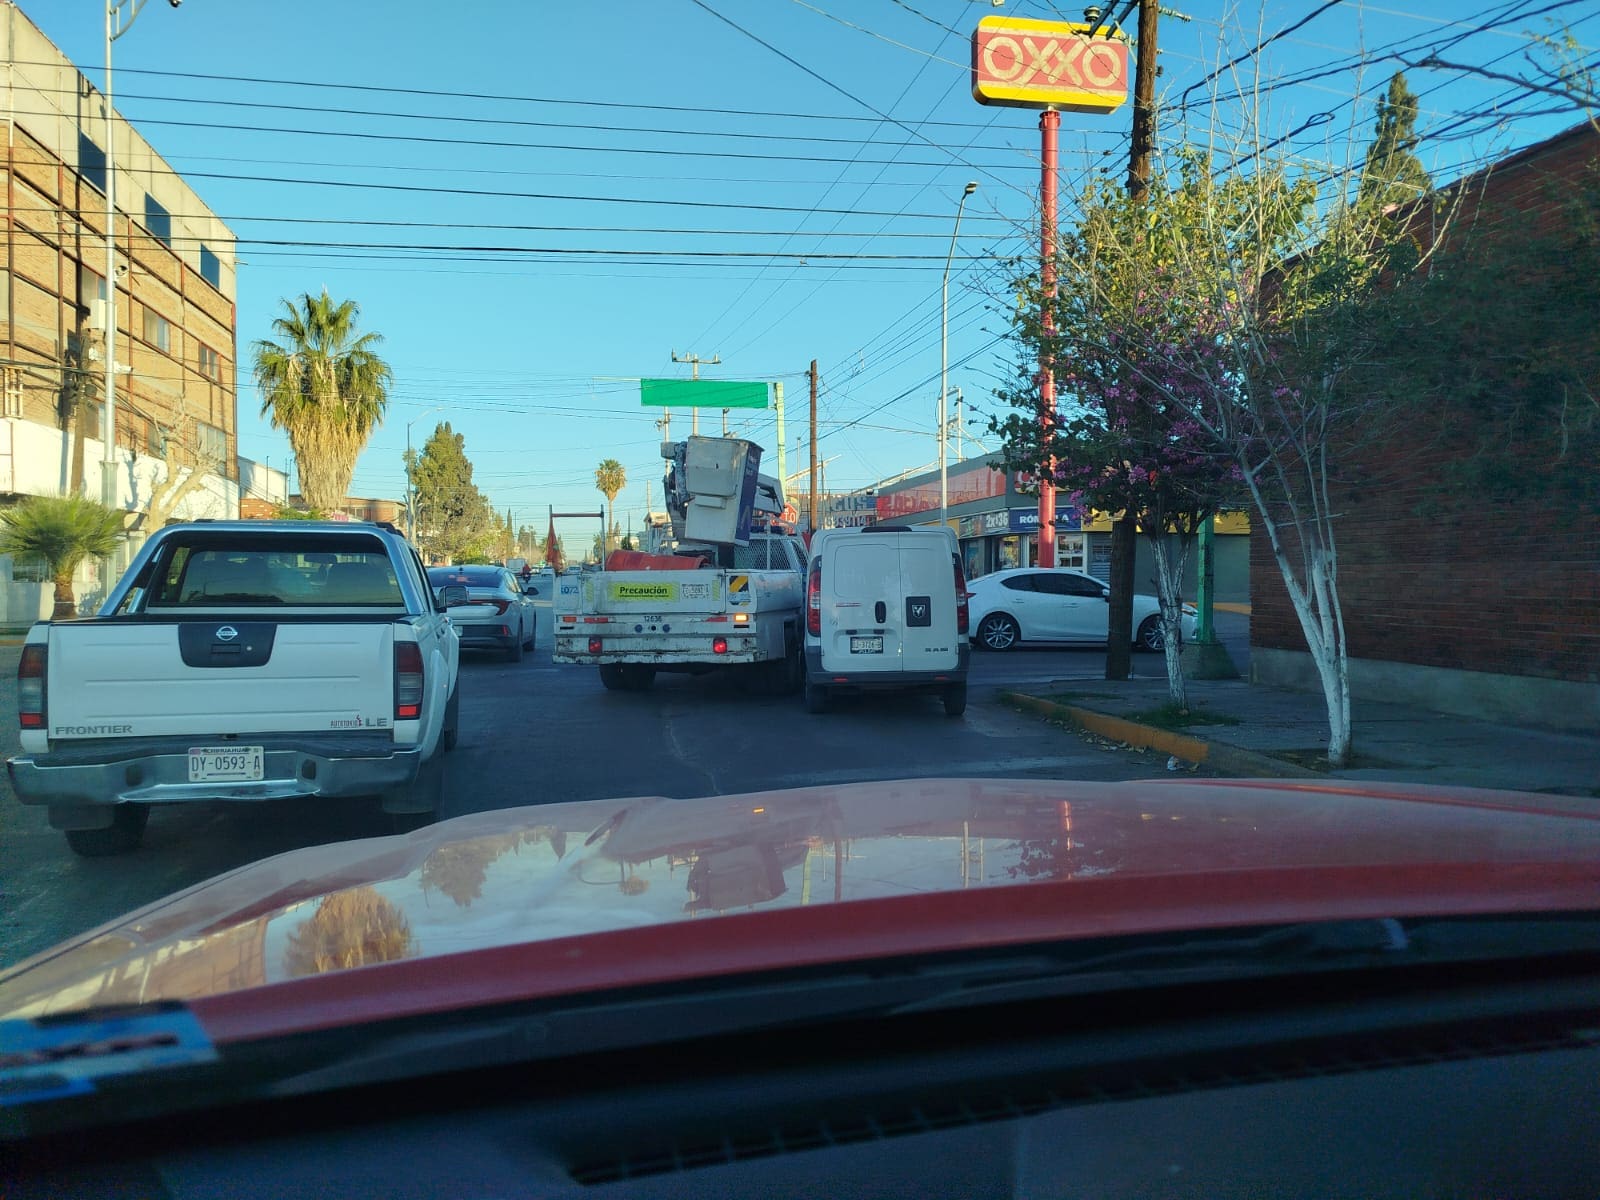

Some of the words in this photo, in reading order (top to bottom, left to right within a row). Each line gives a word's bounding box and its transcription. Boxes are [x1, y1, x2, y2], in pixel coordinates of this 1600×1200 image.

[983, 37, 1121, 87] OXXO
[619, 586, 668, 595] Precaución
[365, 717, 388, 727] LE
[55, 724, 133, 735] FRONTIER
[191, 755, 261, 772] DY-0593-A
